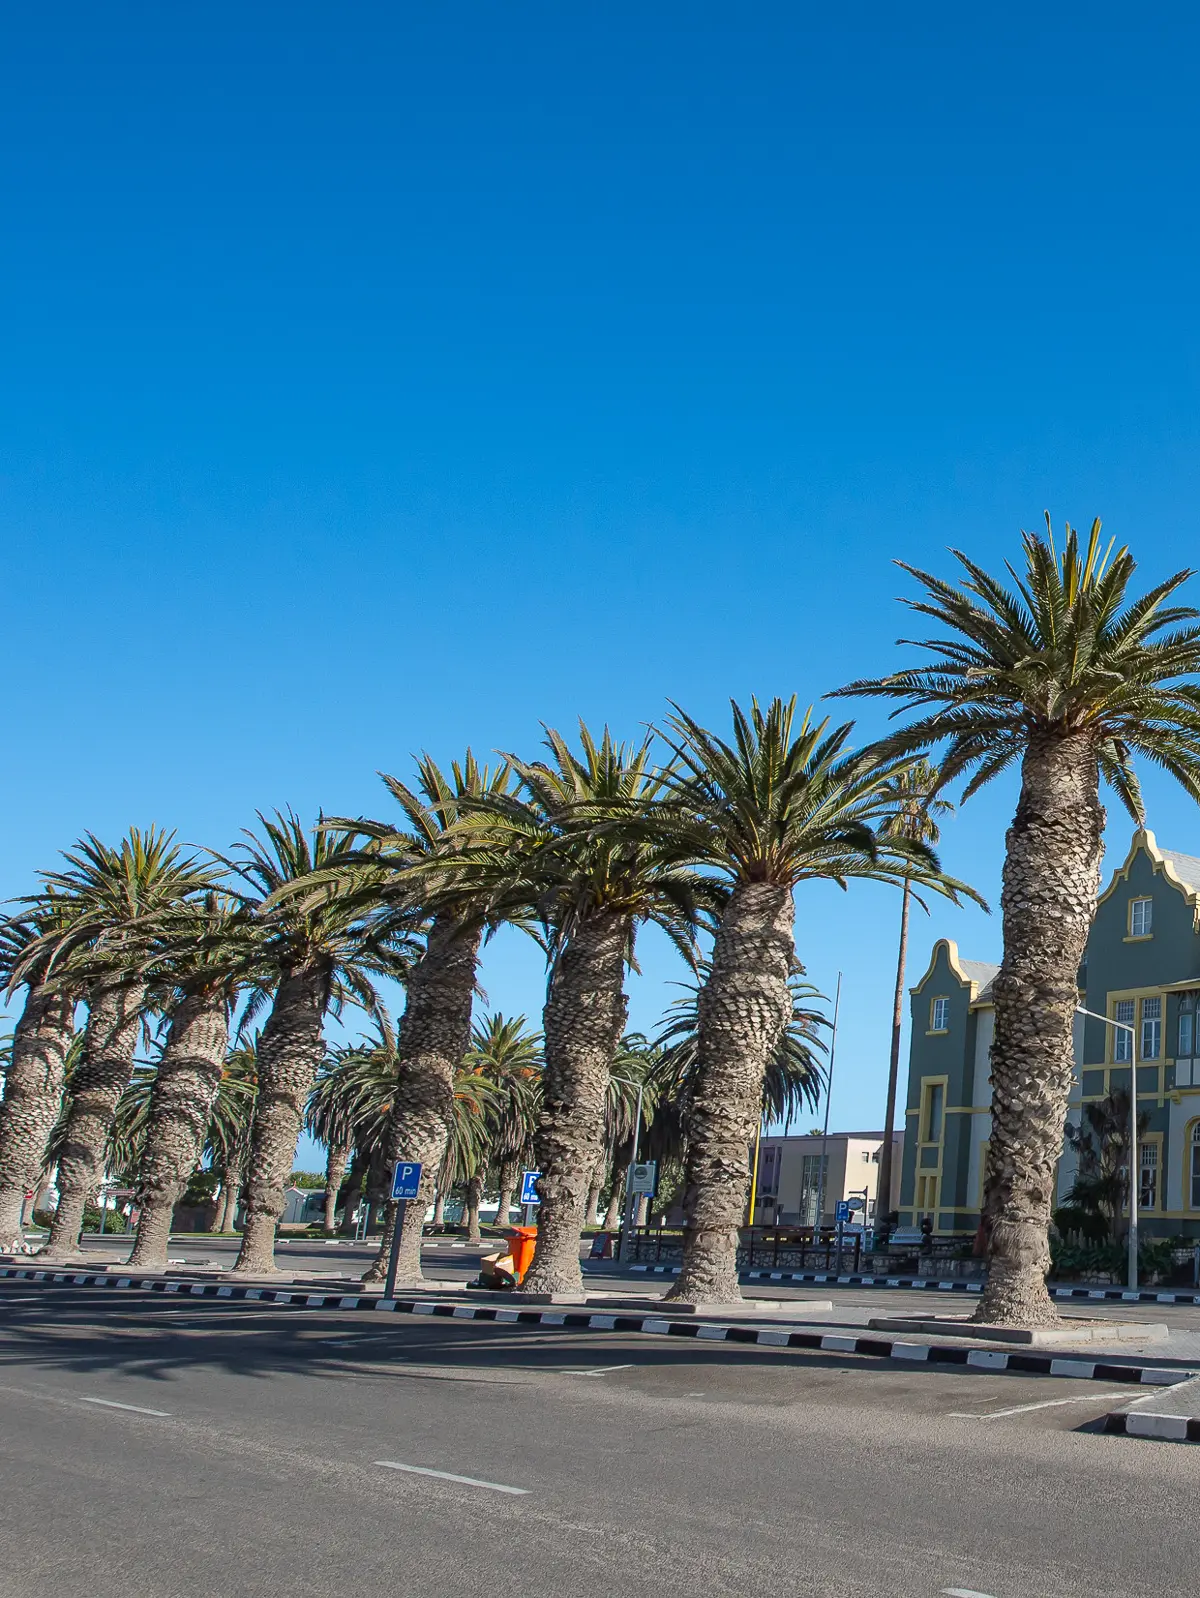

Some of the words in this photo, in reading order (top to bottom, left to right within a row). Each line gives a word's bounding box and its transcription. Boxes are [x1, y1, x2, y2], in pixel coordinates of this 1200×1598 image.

[401, 1166, 413, 1180] P
[395, 1186, 403, 1195] 60
[404, 1186, 416, 1195] min
[838, 1202, 848, 1214] P
